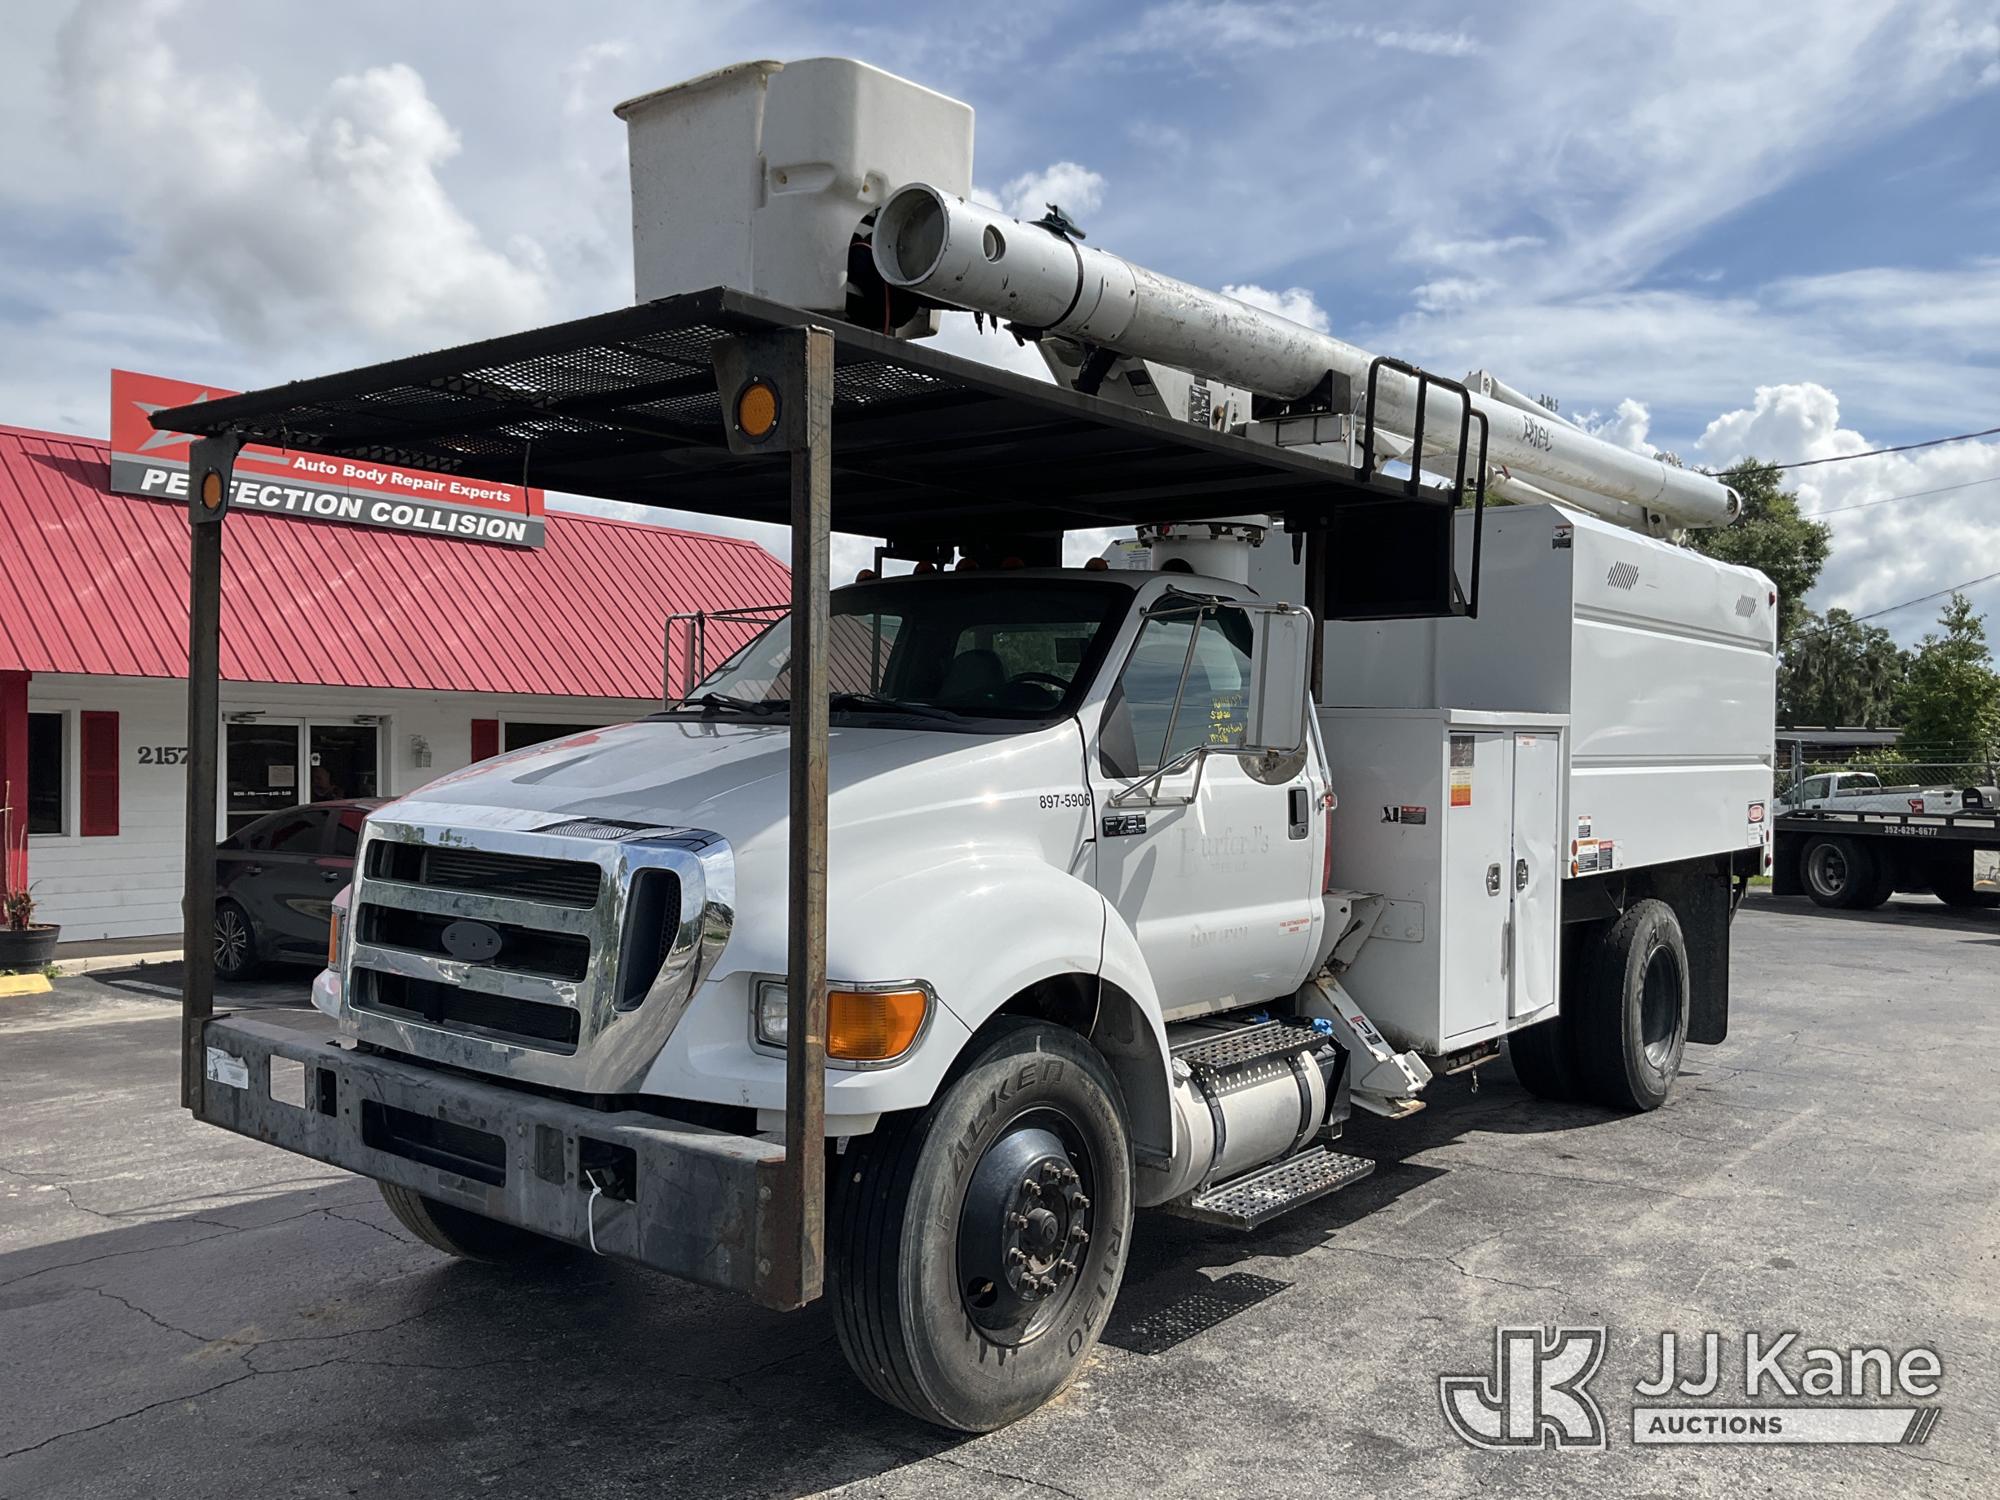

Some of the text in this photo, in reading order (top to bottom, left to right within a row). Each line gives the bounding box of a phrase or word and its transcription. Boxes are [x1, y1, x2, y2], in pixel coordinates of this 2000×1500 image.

[293, 456, 512, 503] Auto Body Repair Experts
[140, 468, 527, 542] PEECTION COLLISION
[1039, 793, 1091, 809] 897-5906
[1884, 825, 1938, 836] 352-629-6677
